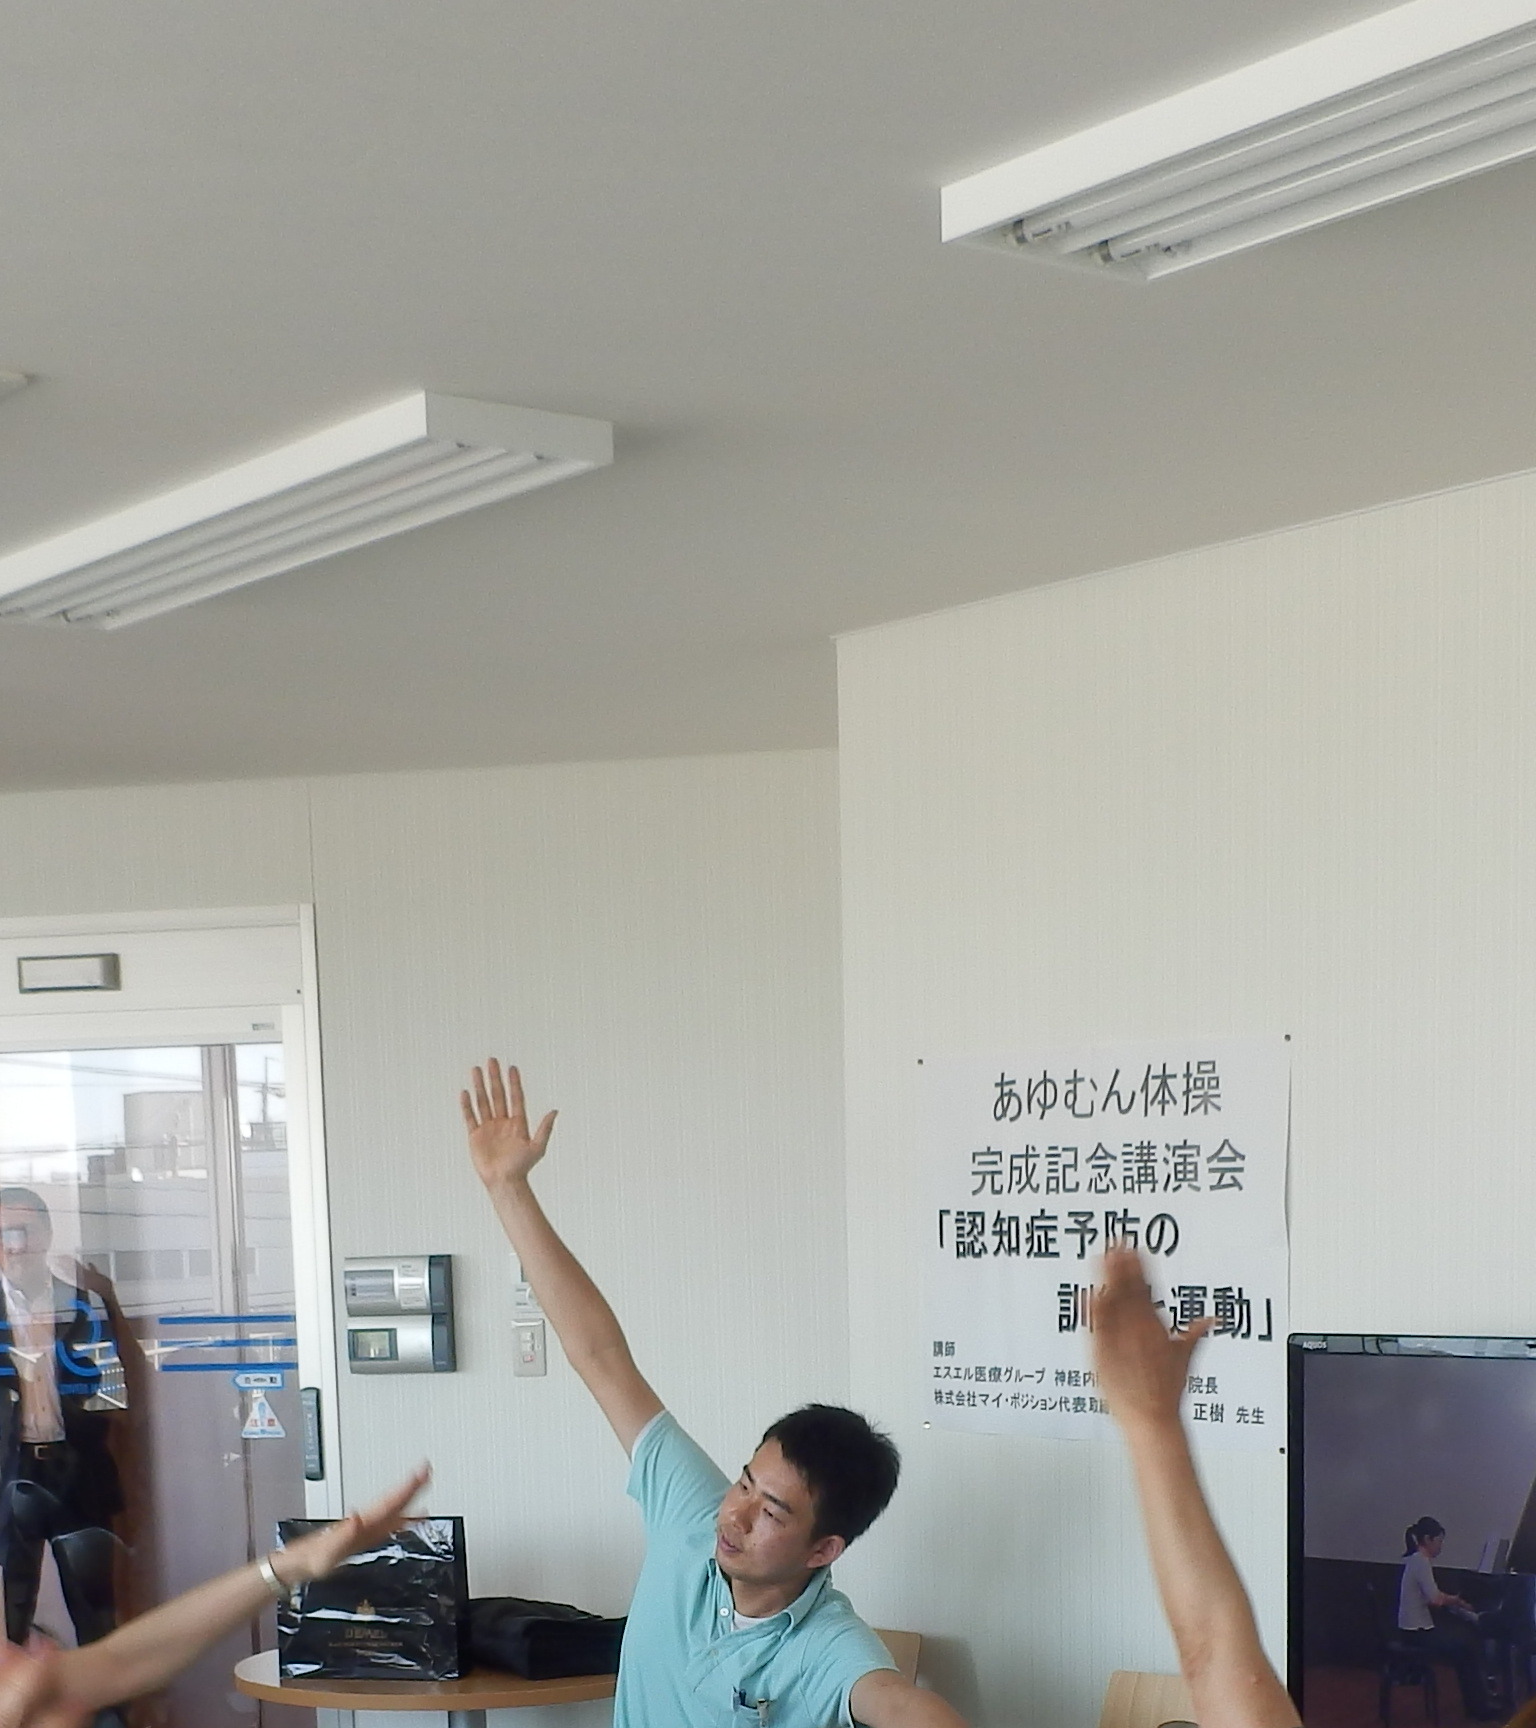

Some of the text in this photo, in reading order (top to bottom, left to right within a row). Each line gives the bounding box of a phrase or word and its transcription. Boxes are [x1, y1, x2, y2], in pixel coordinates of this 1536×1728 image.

[992, 1060, 1222, 1122] あゆむん体操
[971, 1138, 1246, 1195] 完成記念講演会
[938, 1208, 1180, 1260] 「認知症予防の
[933, 1341, 955, 1358] 講師
[933, 1366, 1046, 1385] エスエル医療グループ
[1193, 1402, 1224, 1423] 正樹
[1236, 1406, 1265, 1425] 先生
